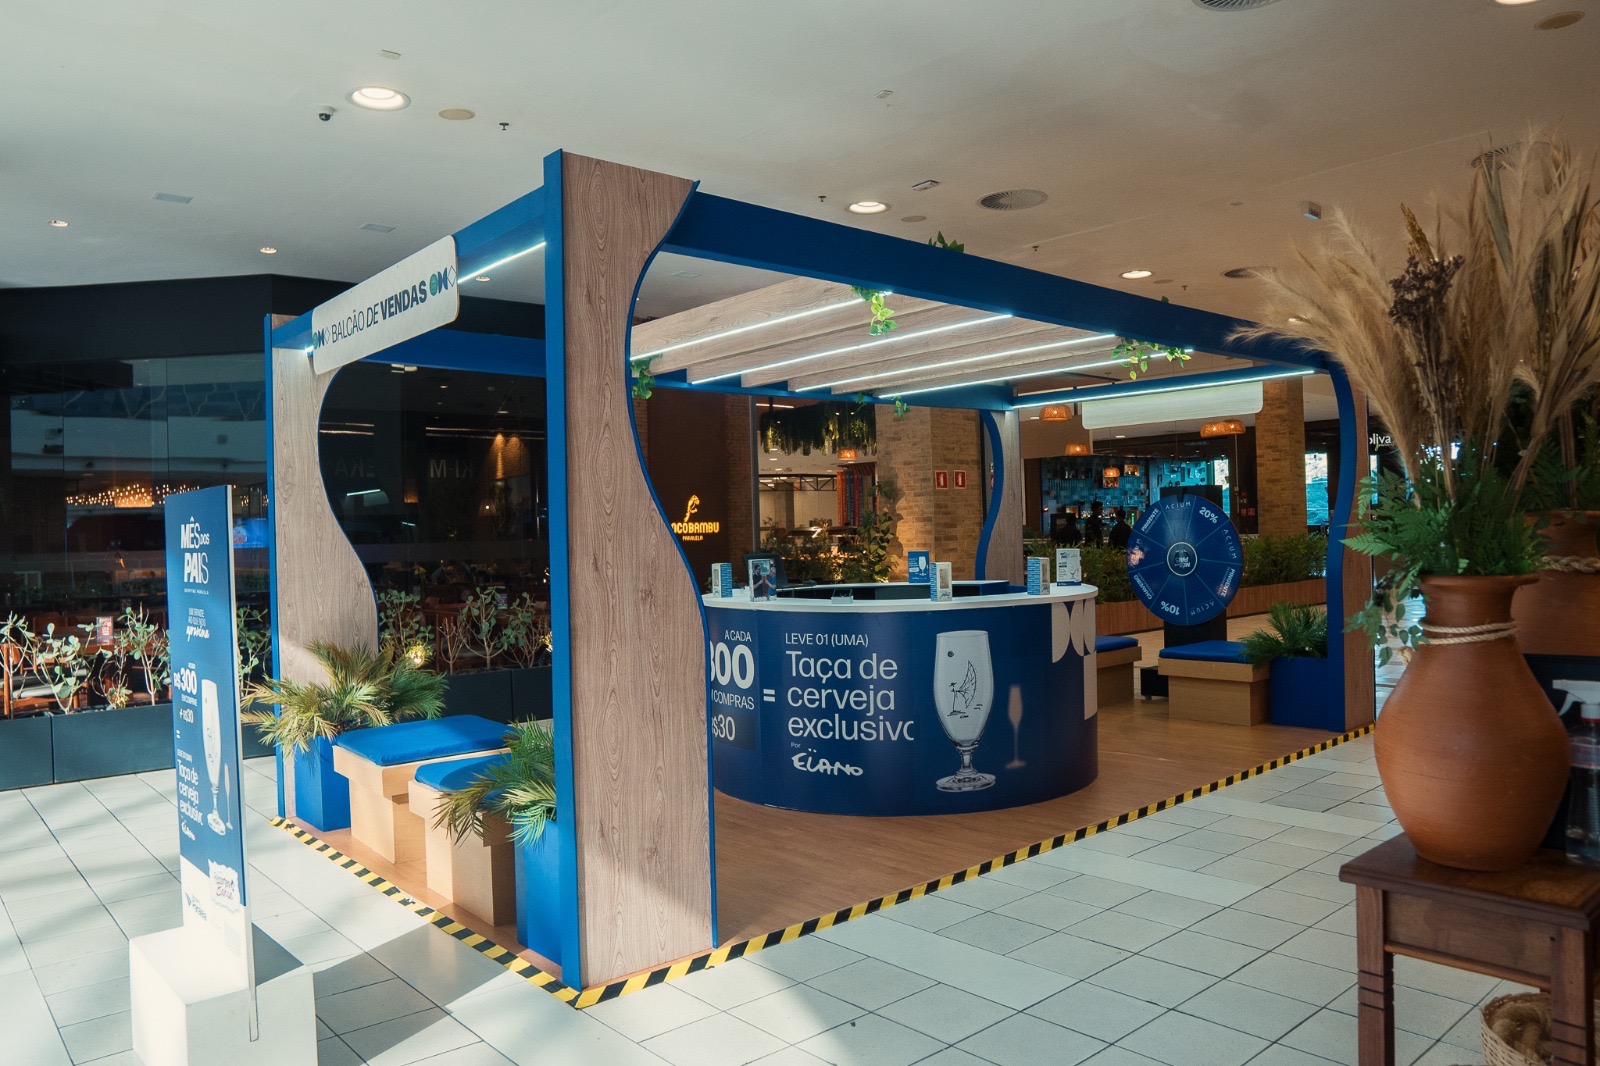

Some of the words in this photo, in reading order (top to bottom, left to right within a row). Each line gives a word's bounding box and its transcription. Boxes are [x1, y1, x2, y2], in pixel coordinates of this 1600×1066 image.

[332, 310, 365, 343] BALCÃO
[366, 303, 379, 328] DE
[380, 280, 427, 320] VENDAS
[1199, 506, 1219, 524] 20%
[180, 516, 201, 549] MÊS
[200, 533, 210, 545] DOS
[183, 552, 209, 584] PAIS
[1160, 601, 1180, 616] 10%
[725, 630, 730, 640] A
[730, 630, 752, 642] CADA
[785, 633, 814, 645] LEVE
[815, 633, 829, 645] 01
[831, 634, 869, 647] (UMA)
[786, 650, 852, 684] Taça
[859, 653, 898, 679] de
[713, 690, 755, 711] COMPRAS
[787, 685, 895, 716] cerveja
